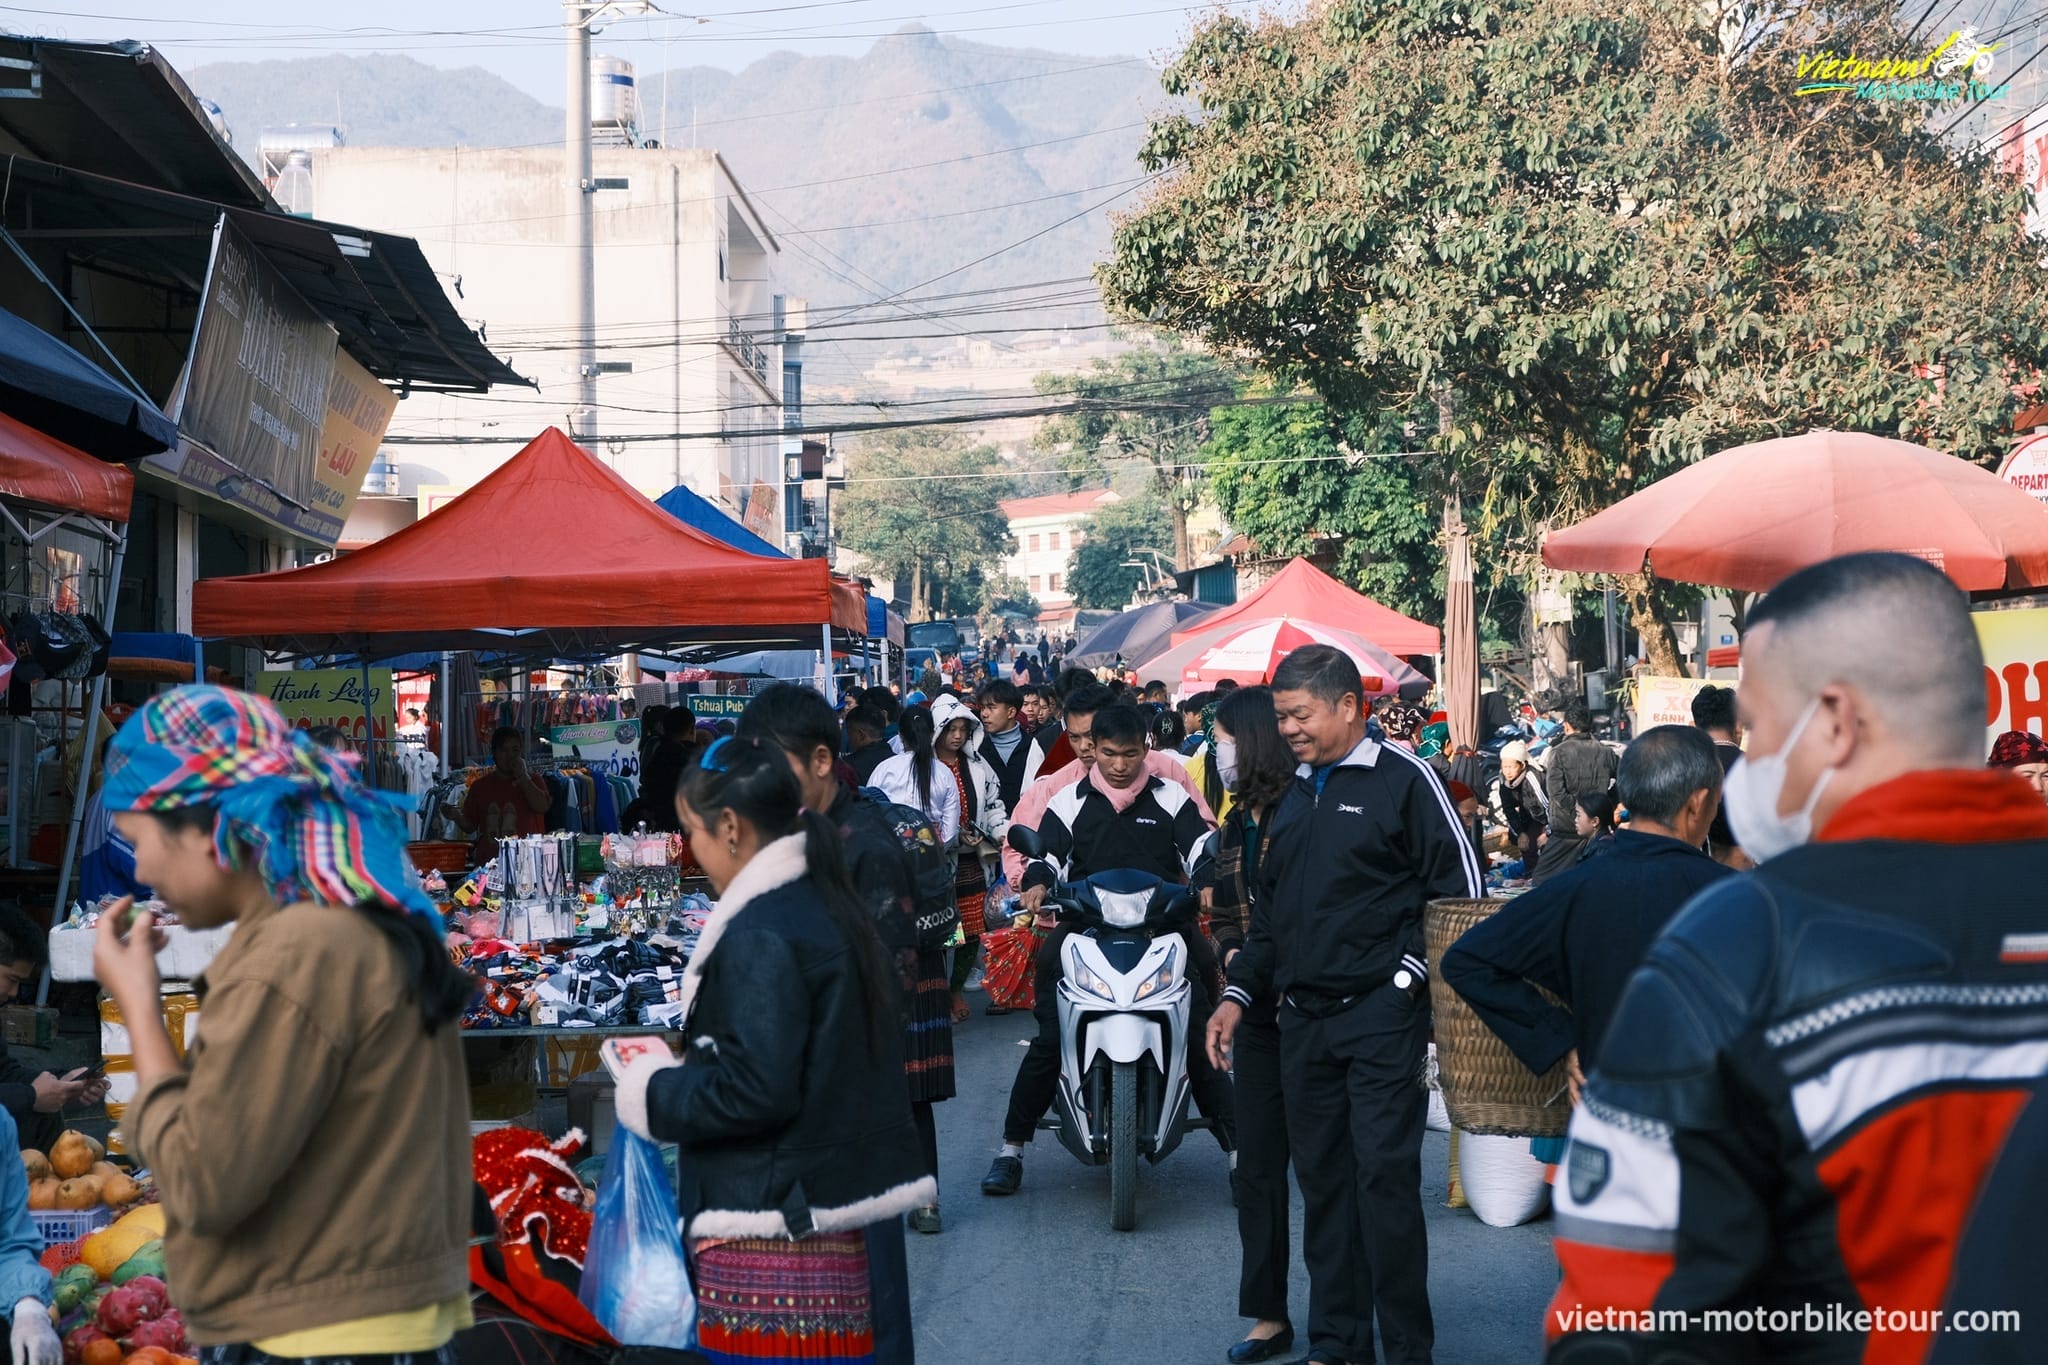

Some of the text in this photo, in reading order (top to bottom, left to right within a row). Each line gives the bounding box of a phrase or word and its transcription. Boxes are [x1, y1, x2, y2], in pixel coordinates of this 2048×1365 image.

[221, 241, 248, 289] SHOP
[270, 676, 320, 703] Hạnh
[328, 677, 380, 706] Leng
[693, 699, 723, 714] Tshuaj
